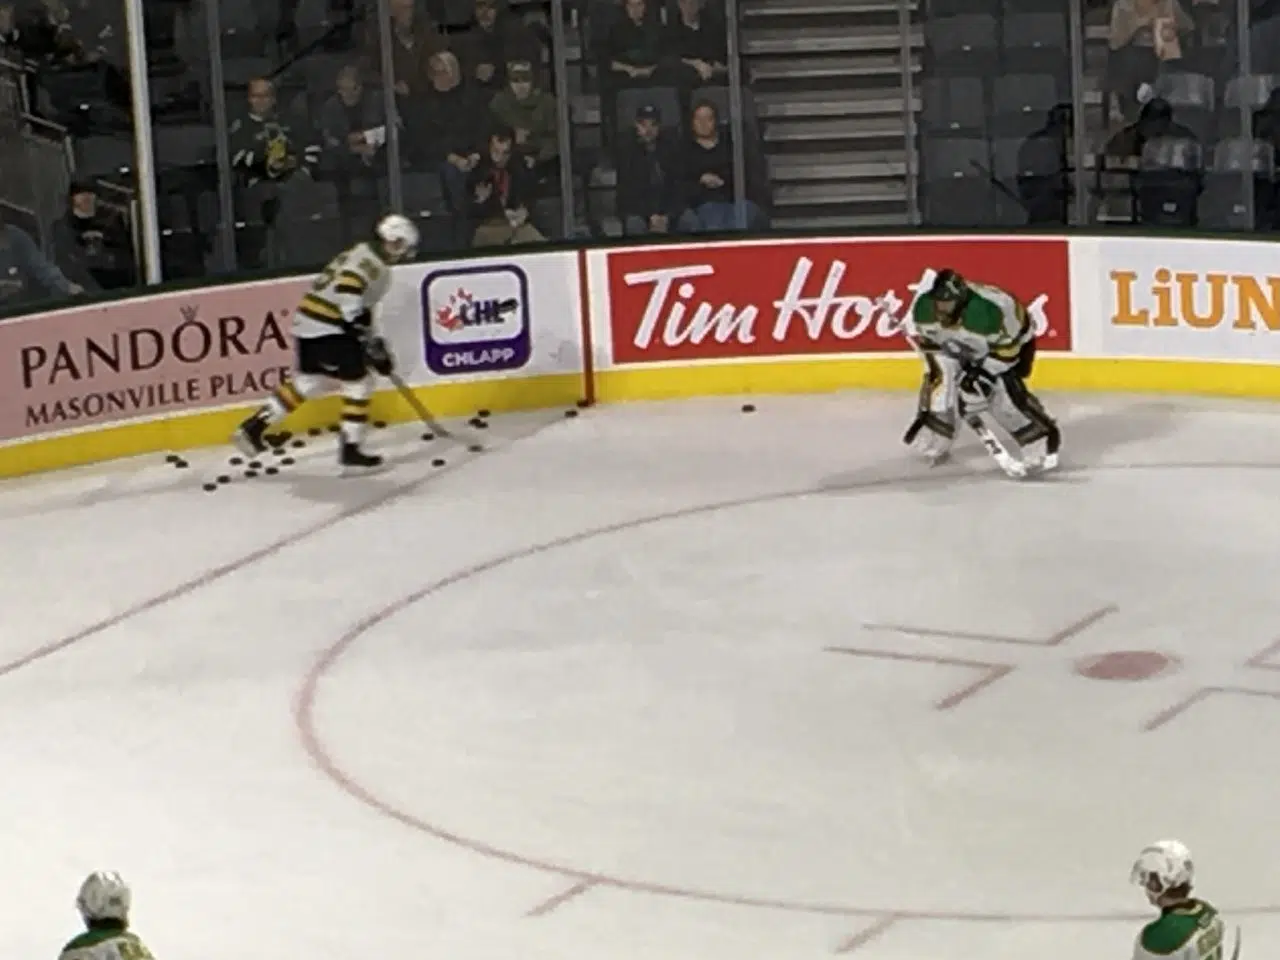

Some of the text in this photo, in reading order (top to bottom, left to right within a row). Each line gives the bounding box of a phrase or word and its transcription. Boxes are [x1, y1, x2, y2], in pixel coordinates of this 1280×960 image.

[623, 256, 1050, 350] Tim Horts
[24, 365, 293, 427] MASONVILLE PLACE
